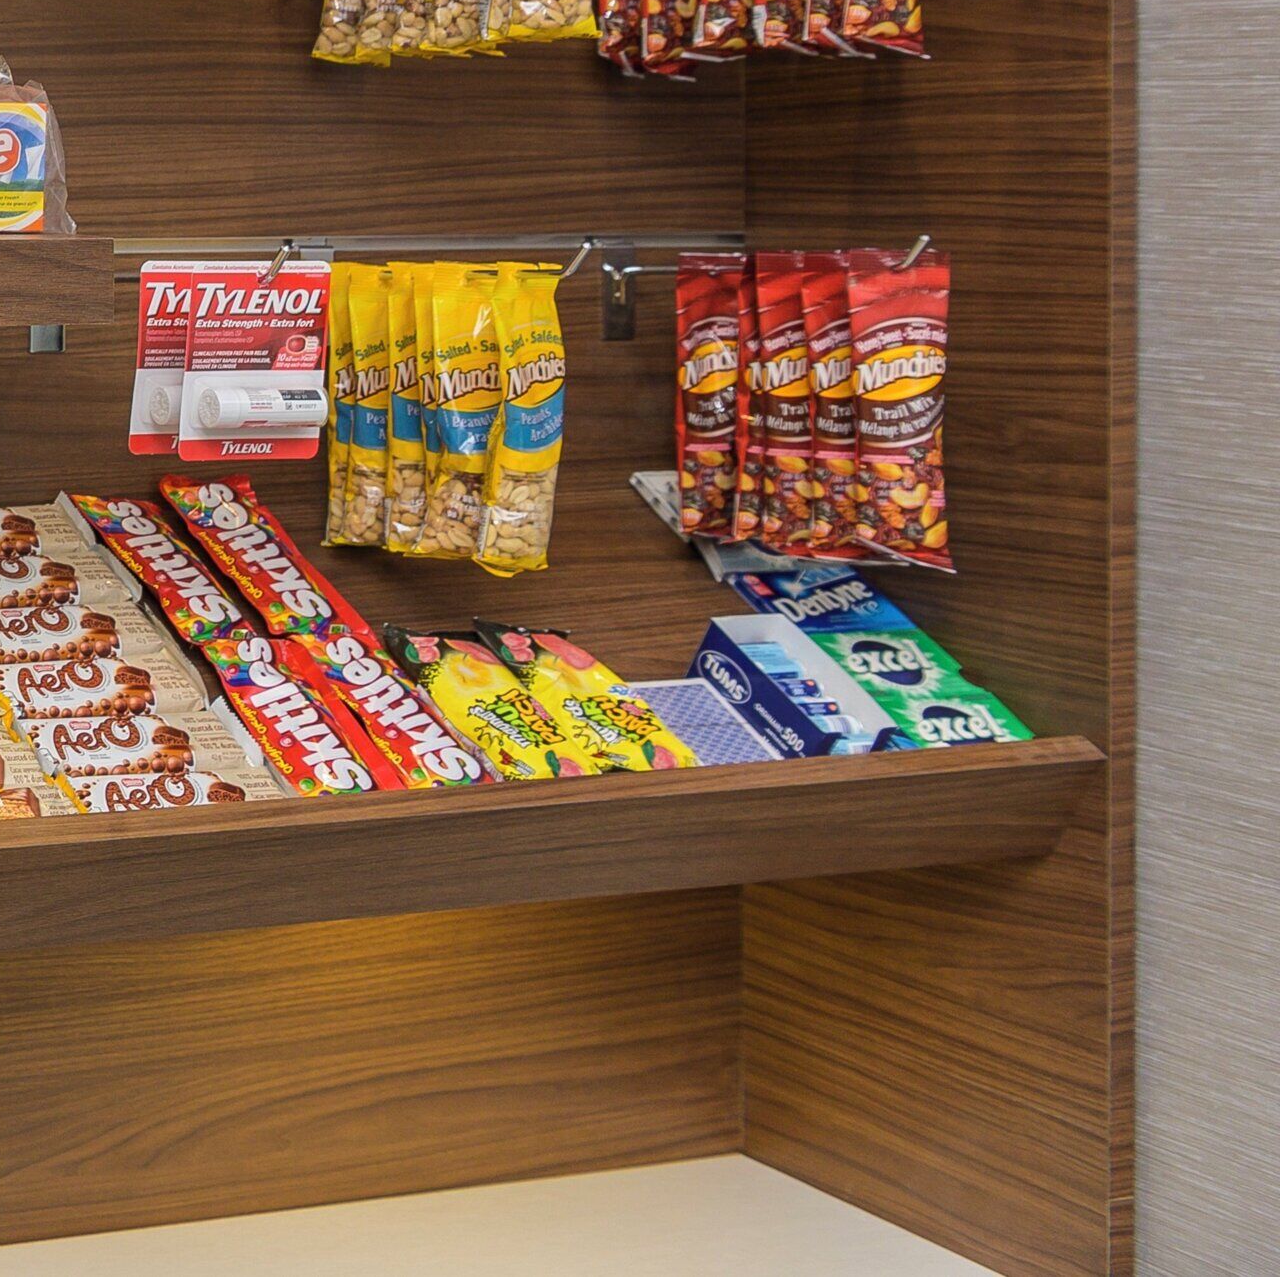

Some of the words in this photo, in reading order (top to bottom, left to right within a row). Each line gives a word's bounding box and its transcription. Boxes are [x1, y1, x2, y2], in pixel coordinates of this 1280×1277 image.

[195, 282, 322, 318] TYLENOL
[195, 318, 217, 328] Extra
[218, 319, 263, 330] Strength
[269, 318, 293, 328] Extra
[294, 318, 315, 328] fort
[855, 348, 947, 395] Munchies
[221, 441, 273, 455] TYLENOL
[774, 578, 875, 622] Dentyne
[846, 638, 932, 673] excel
[703, 654, 748, 702] TUMS
[501, 689, 565, 745] PATCH
[918, 705, 1004, 742] excel
